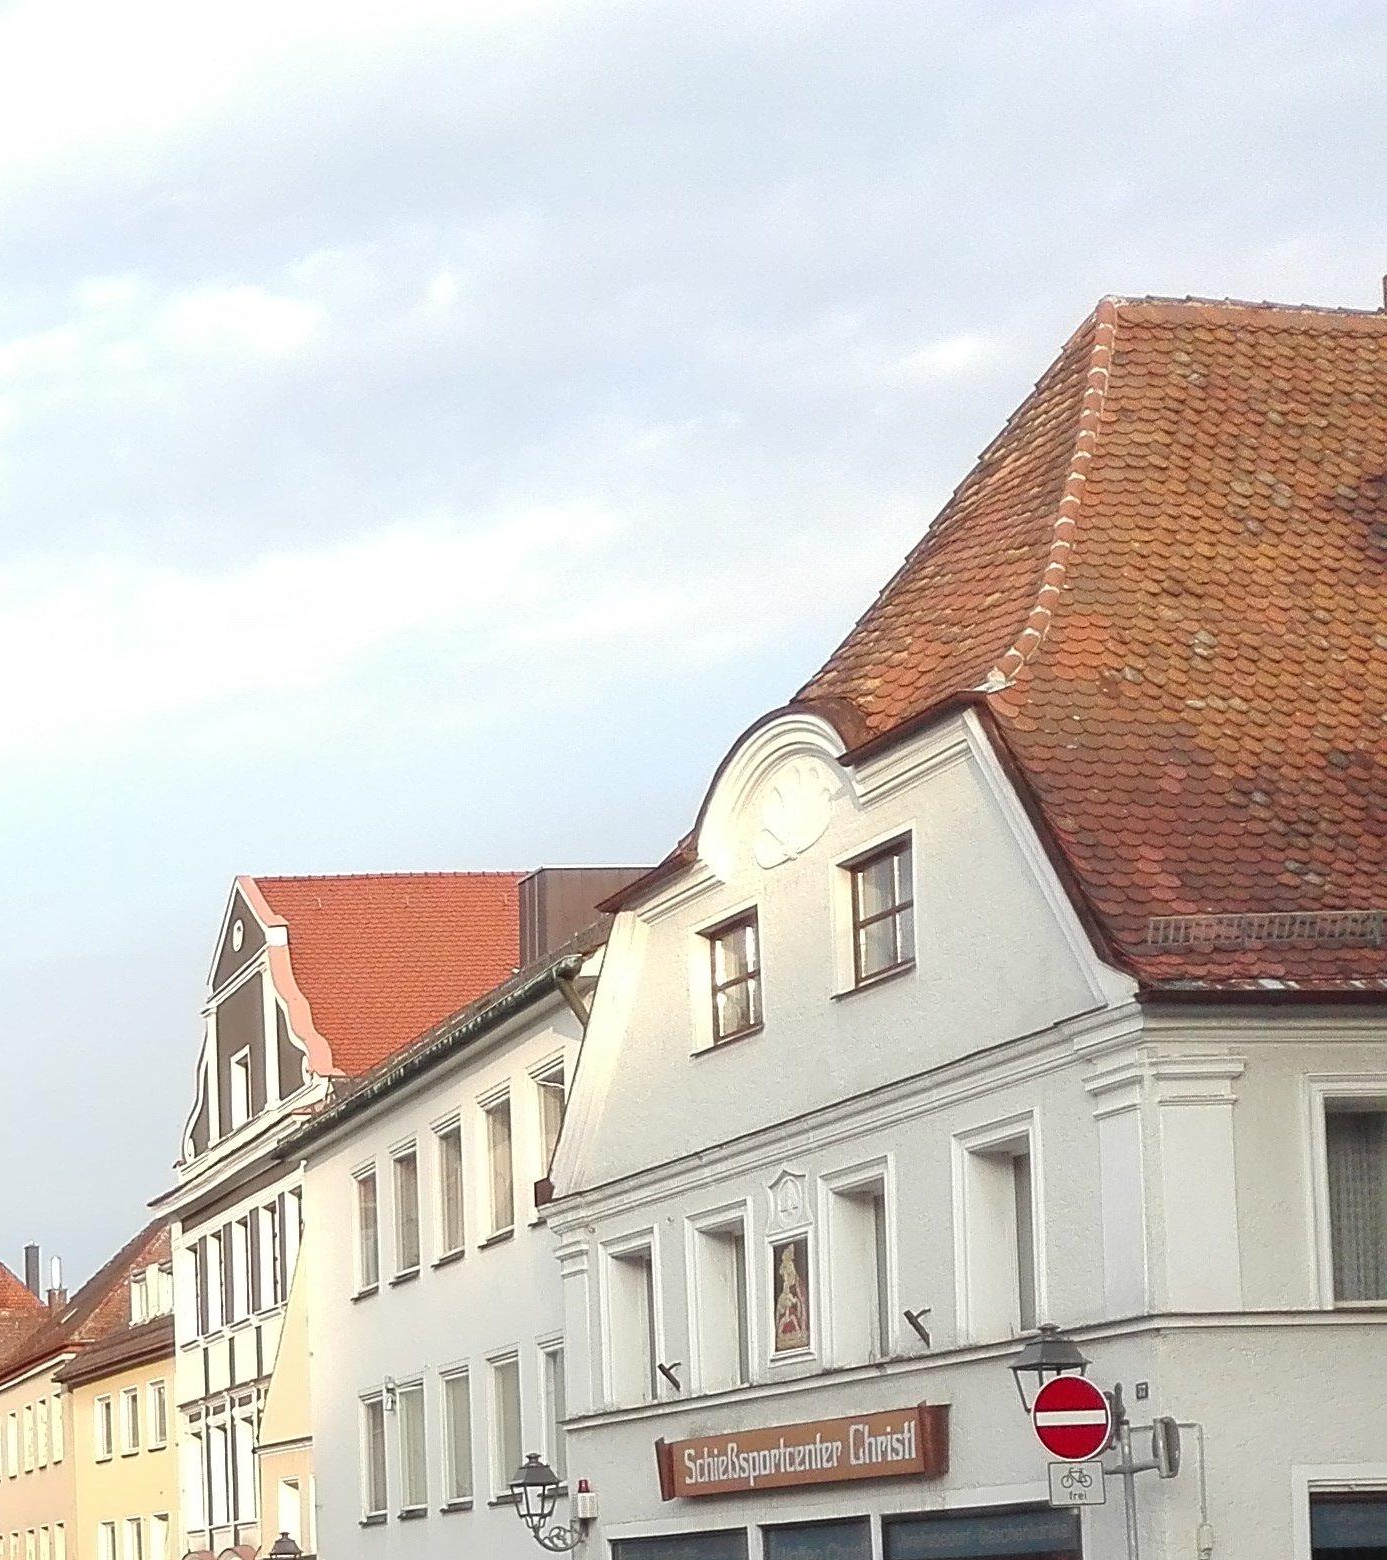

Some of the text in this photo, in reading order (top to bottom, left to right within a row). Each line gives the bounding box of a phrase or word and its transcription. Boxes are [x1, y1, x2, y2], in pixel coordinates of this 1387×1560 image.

[684, 1420, 916, 1486] Schießsportcenter Christl
[1069, 1490, 1087, 1500] frei
